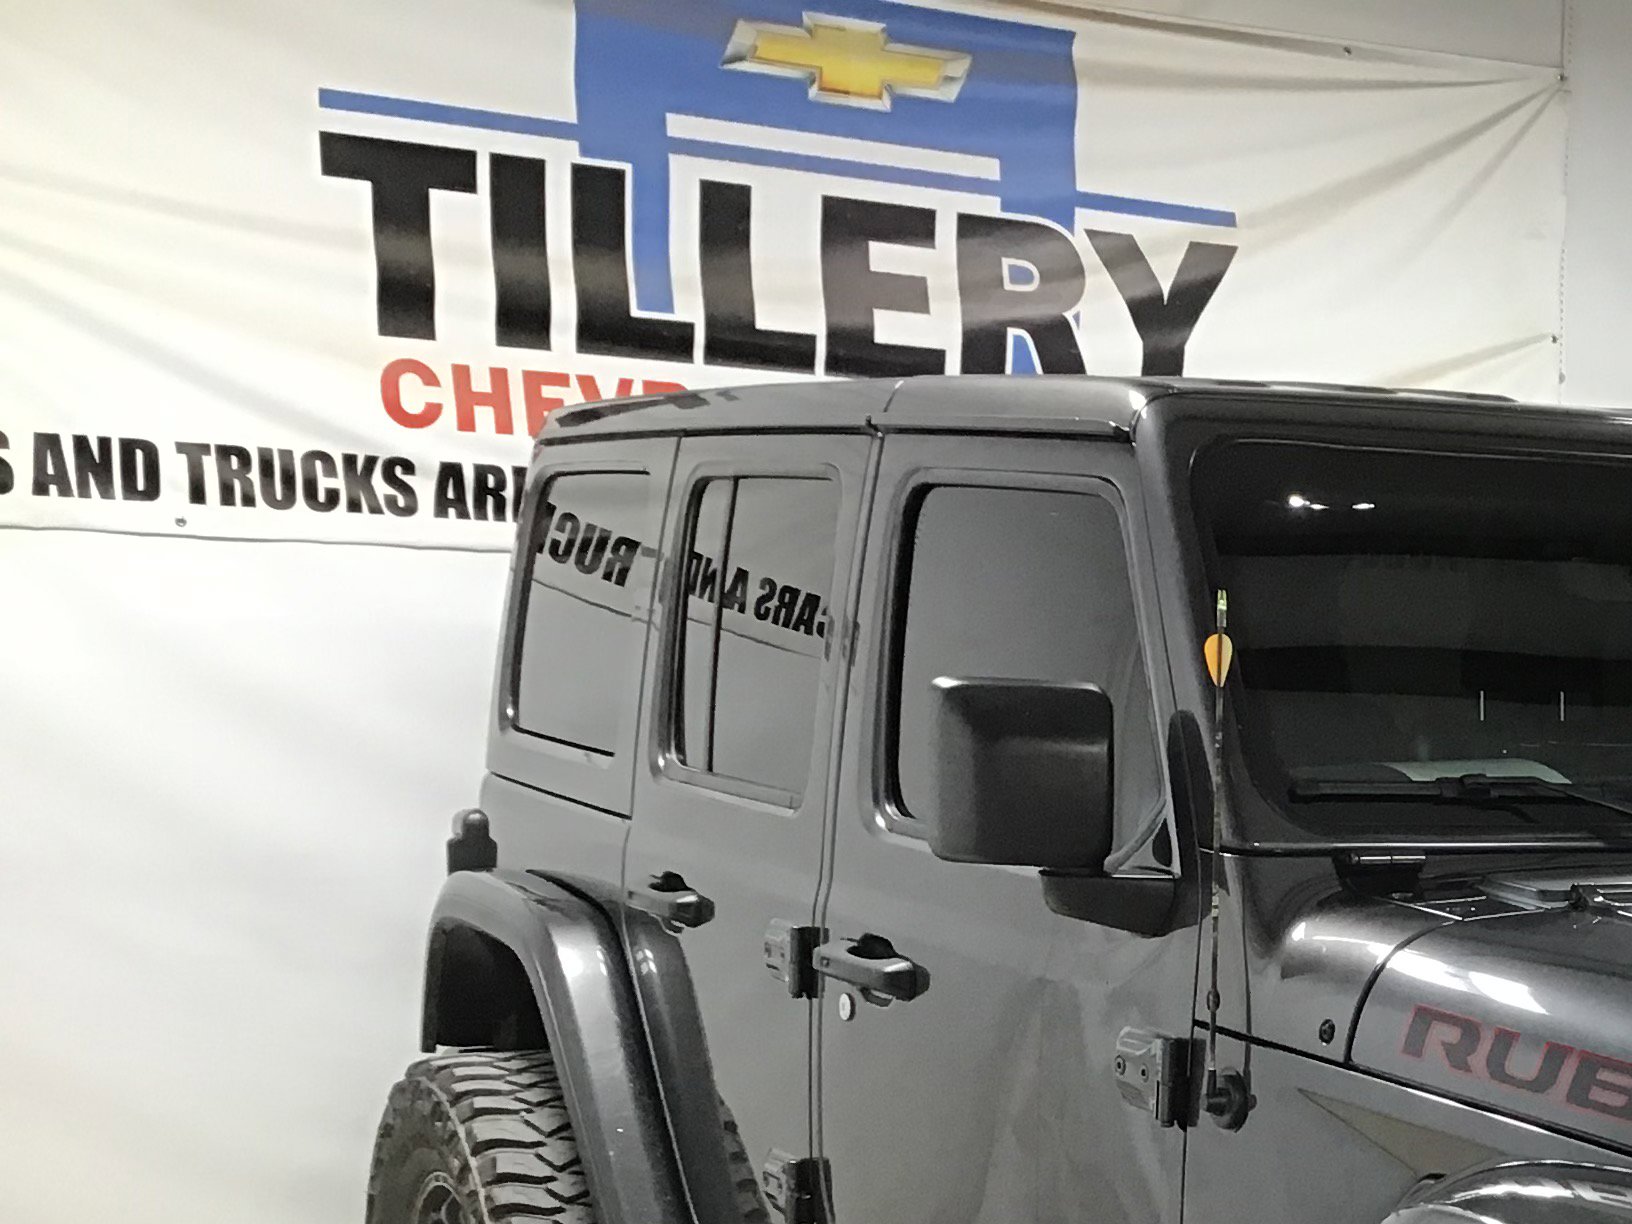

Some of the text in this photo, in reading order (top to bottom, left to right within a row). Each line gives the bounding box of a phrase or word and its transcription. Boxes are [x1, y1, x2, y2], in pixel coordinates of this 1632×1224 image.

[319, 130, 1238, 376] TILLERY
[31, 431, 162, 502] AND
[174, 440, 419, 518] TRUCKS
